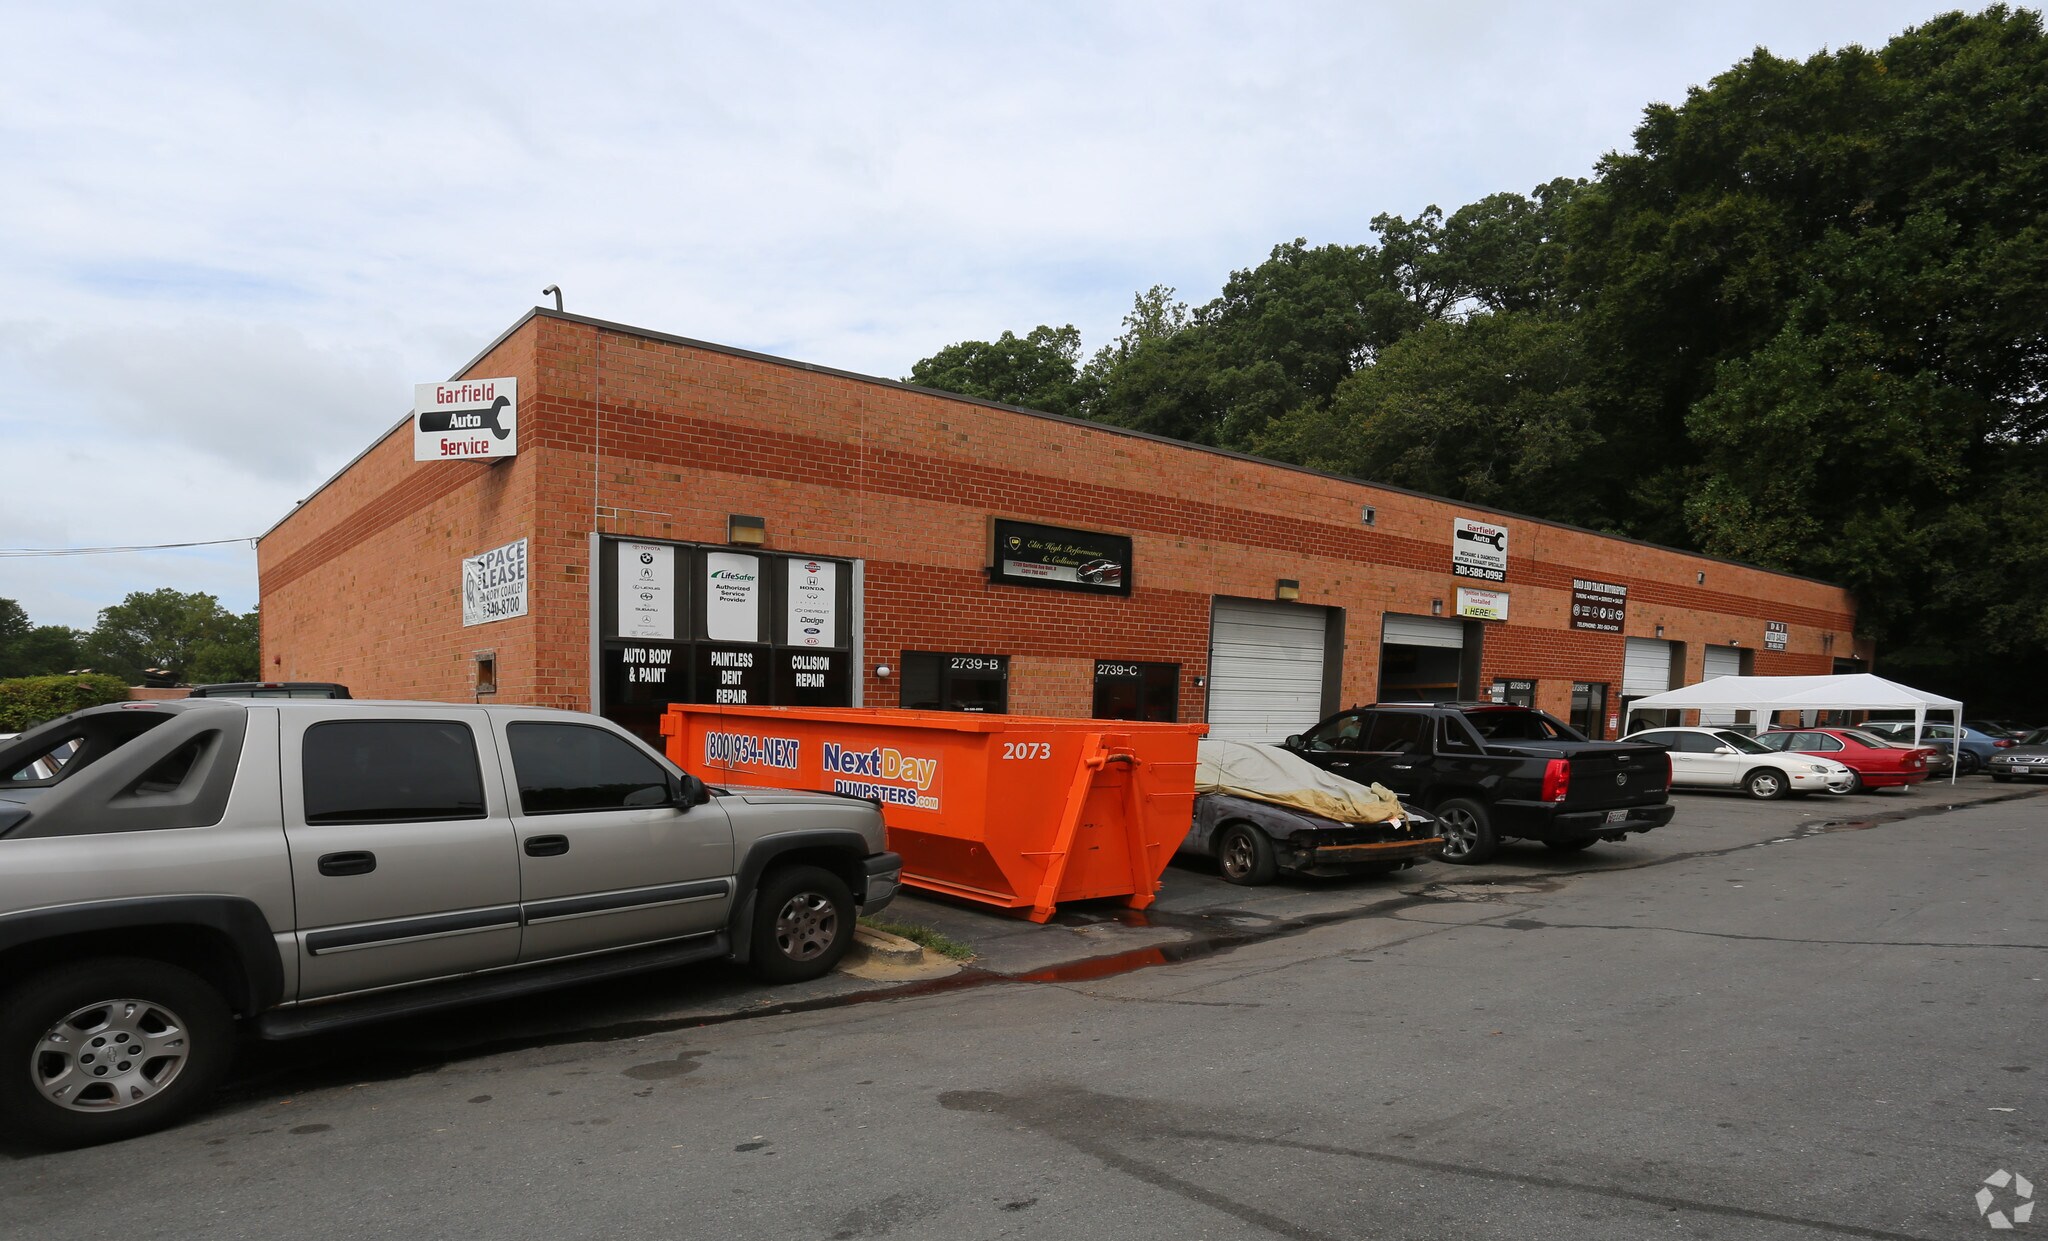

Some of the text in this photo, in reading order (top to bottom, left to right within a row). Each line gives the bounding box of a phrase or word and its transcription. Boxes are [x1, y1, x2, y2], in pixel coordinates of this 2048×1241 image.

[437, 383, 494, 404] Garfield
[449, 413, 481, 428] Auto
[441, 437, 489, 456] Service
[1467, 524, 1495, 535] Garfield
[1473, 533, 1490, 543] Auto
[478, 541, 525, 572] SPACE
[1027, 540, 1043, 549] Elite
[1044, 542, 1061, 553] High
[1063, 546, 1103, 557] Performance
[1051, 556, 1079, 566] Collision
[482, 560, 525, 590] LEASE
[721, 572, 755, 581] LifeSafer
[1455, 565, 1503, 581] 301-588-0992
[486, 596, 520, 618] 340-8700
[800, 616, 824, 625] Dodge
[623, 648, 672, 664] AUTO BODY
[711, 651, 753, 668] PAINTLESS
[791, 655, 830, 671] COLLISION
[951, 657, 998, 670] 2739-B
[628, 666, 666, 683] & PAINT
[721, 670, 742, 685] DENT
[1097, 664, 1137, 676] 2739-C
[795, 673, 825, 688] REPAIR
[716, 689, 747, 704] REPAIR
[705, 731, 799, 769] (800)954-NEXT
[1002, 742, 1051, 760] 2073
